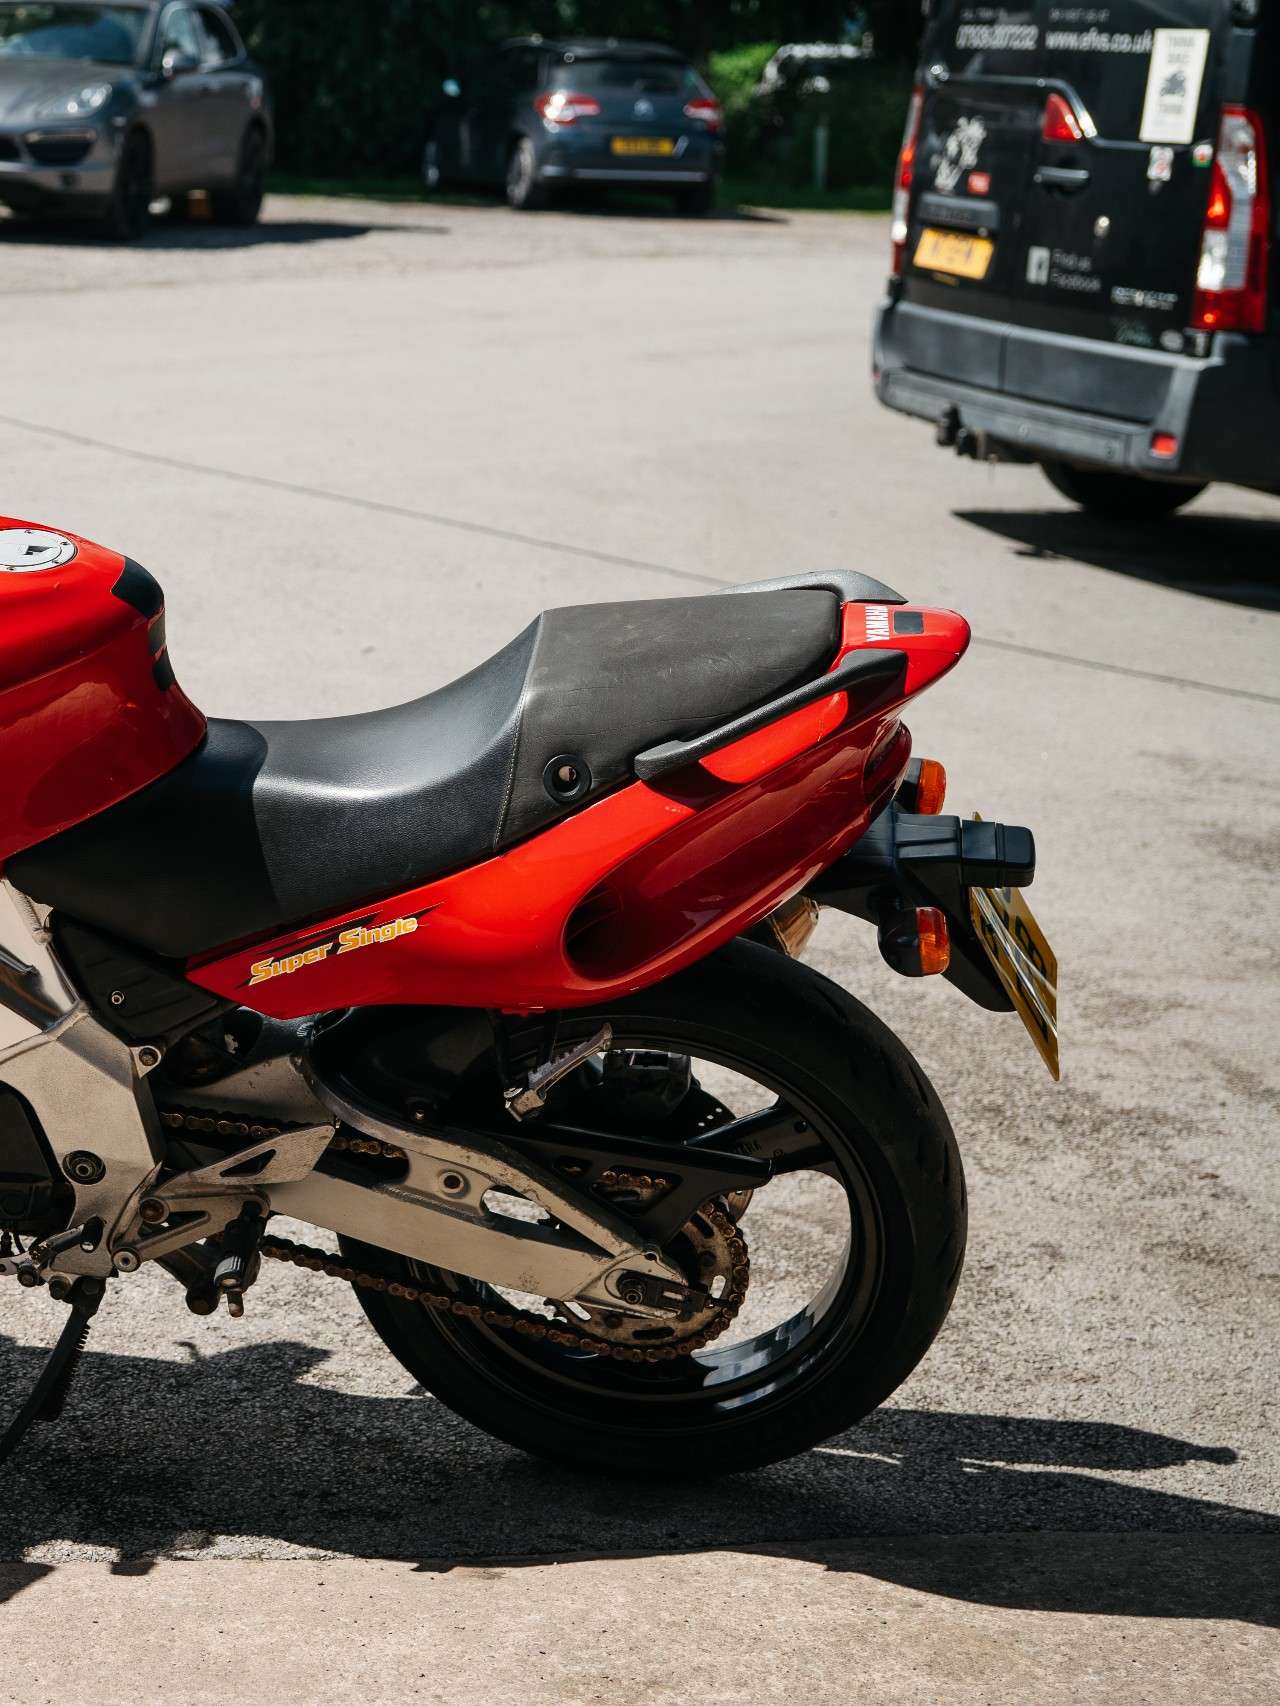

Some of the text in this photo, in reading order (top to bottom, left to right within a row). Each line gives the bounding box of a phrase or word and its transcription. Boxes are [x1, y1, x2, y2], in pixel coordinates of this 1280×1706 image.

[865, 605, 890, 643] YAMAHA
[249, 917, 419, 986] Super Single
